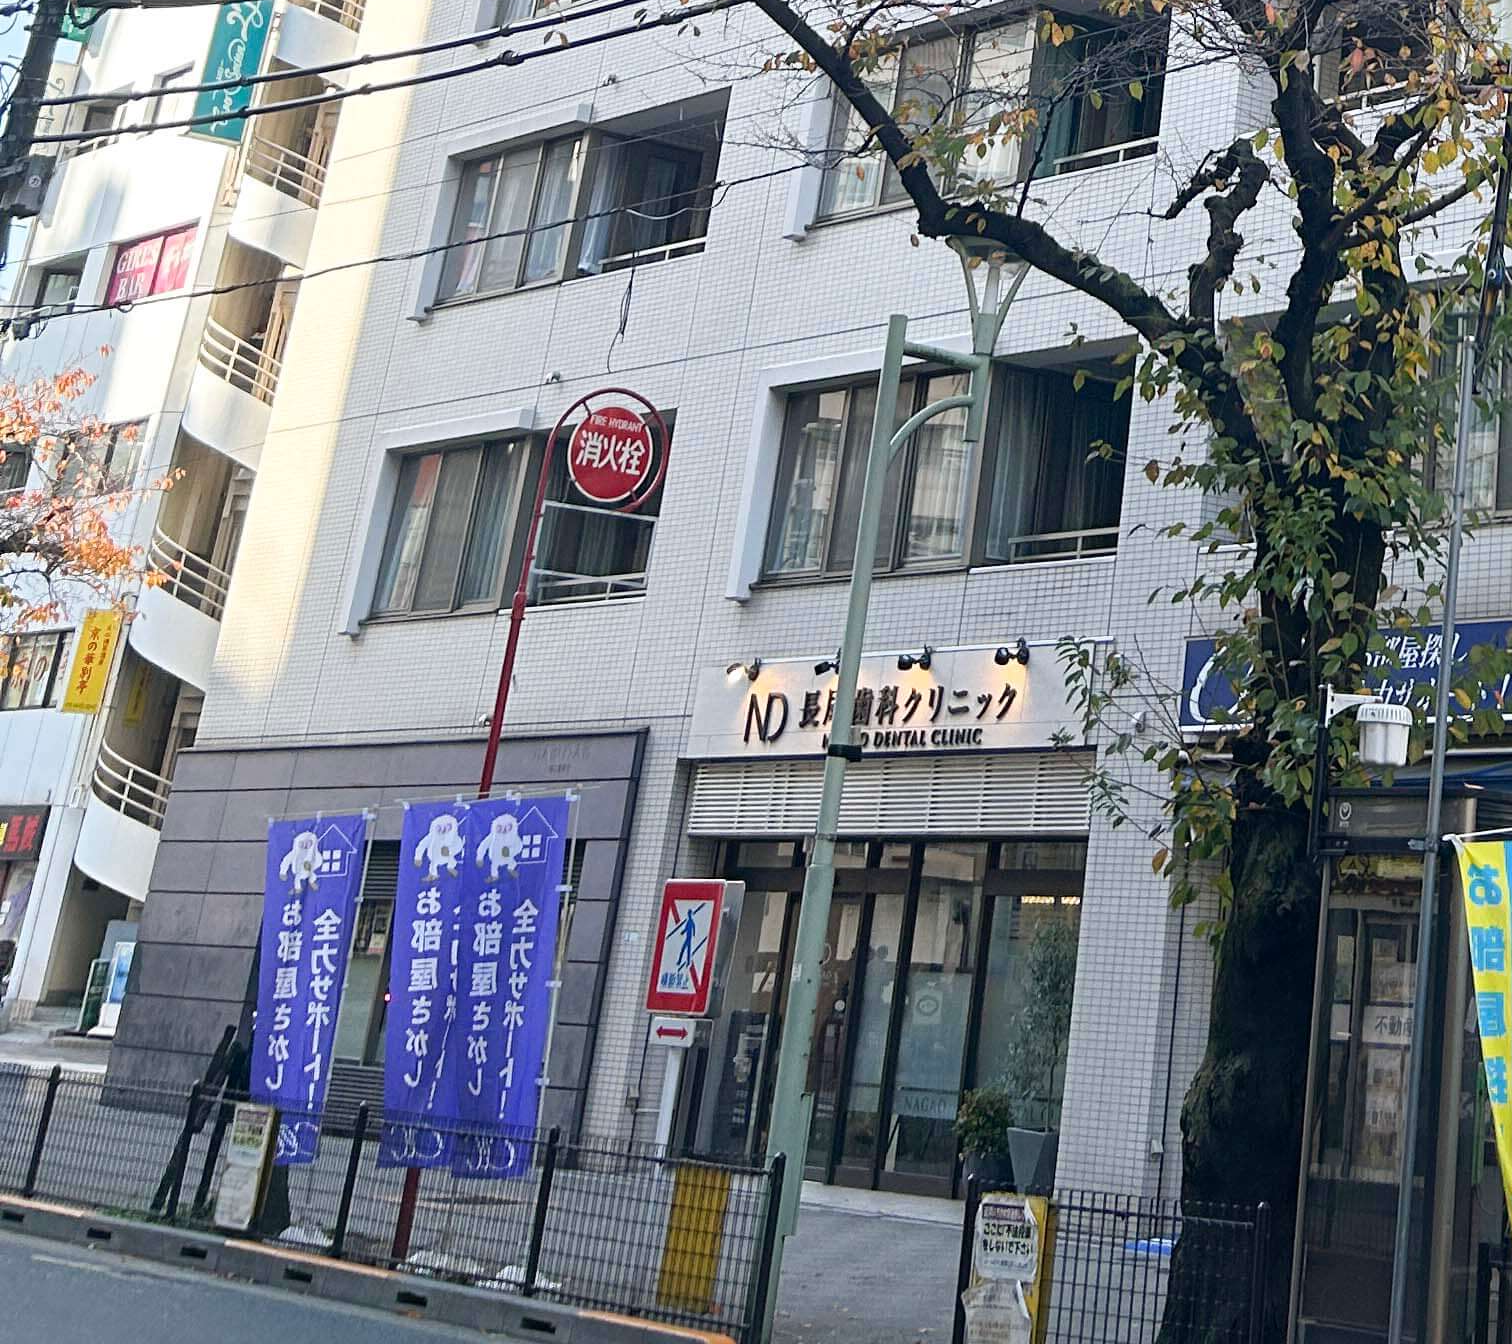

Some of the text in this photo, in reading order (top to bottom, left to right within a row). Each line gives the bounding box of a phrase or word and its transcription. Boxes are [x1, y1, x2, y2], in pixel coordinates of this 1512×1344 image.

[590, 414, 644, 433] FIRE HYDRANT
[575, 429, 646, 476] 消火栓
[873, 728, 926, 749] DENTAL
[931, 726, 984, 747] CLINIC
